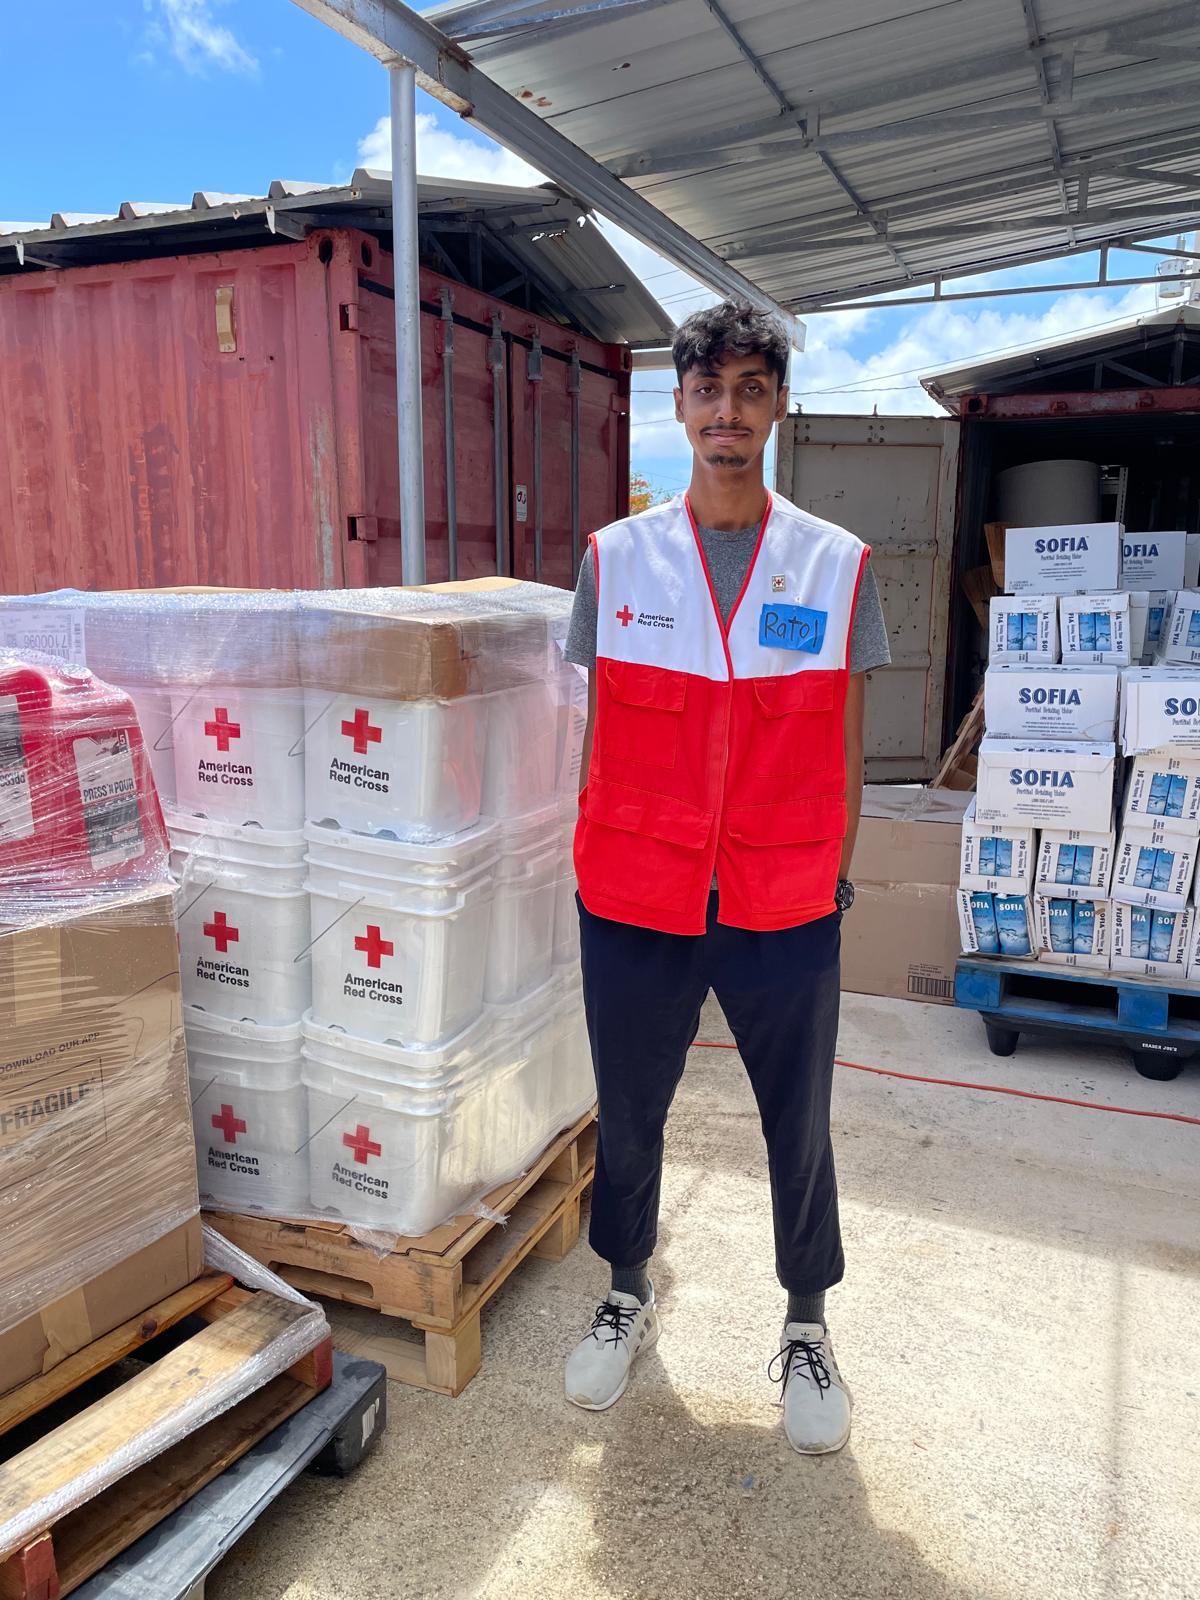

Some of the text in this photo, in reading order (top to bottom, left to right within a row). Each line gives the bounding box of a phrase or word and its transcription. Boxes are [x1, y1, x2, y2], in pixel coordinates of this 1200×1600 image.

[1034, 536, 1089, 553] SOFIA
[1123, 543, 1159, 557] OFIA
[637, 618, 675, 630] Red Cross
[639, 612, 675, 623] American
[1018, 687, 1081, 706] SOFIA
[1164, 697, 1200, 716] SO
[198, 759, 253, 775] American
[330, 757, 390, 782] American
[198, 770, 254, 787] Red Cross
[329, 769, 390, 793] Red Cross
[1009, 768, 1075, 788] SOFIA
[83, 783, 107, 803] PRESS
[114, 778, 135, 795] POUR
[970, 901, 1024, 911] OFIA SOFIA
[1049, 908, 1069, 917] OFIA
[1132, 913, 1147, 922] FIA
[196, 957, 250, 977] American
[196, 967, 250, 988] Red Cross
[344, 973, 403, 993] American
[343, 985, 403, 1005] Red Cross
[58, 1037, 80, 1053] OUR
[80, 1031, 101, 1045] APP
[1, 1078, 96, 1135] FRAGILE
[207, 1146, 259, 1166] American
[207, 1157, 260, 1176] Red Cross
[333, 1162, 390, 1189] American
[331, 1172, 389, 1200] Red Cross
